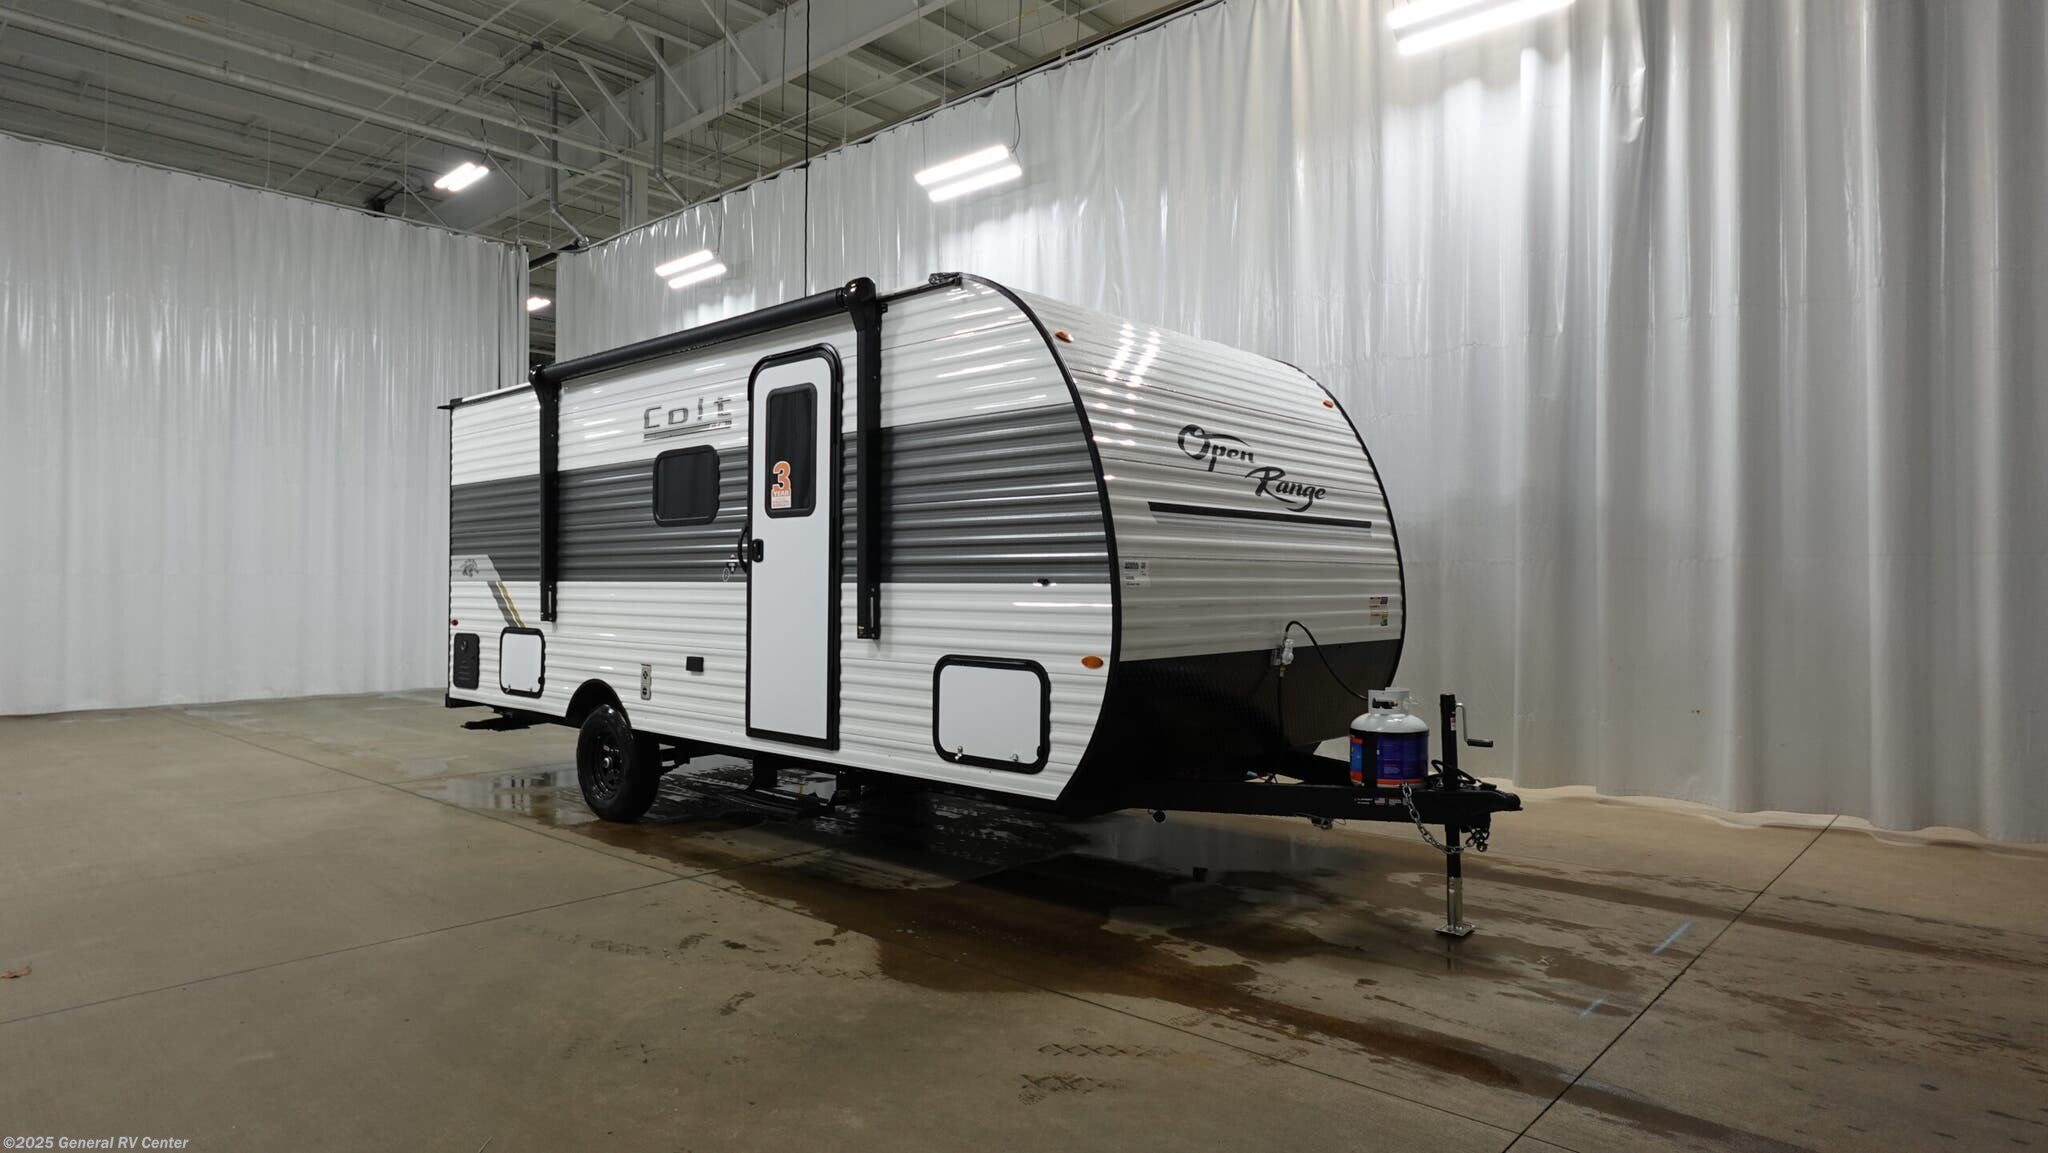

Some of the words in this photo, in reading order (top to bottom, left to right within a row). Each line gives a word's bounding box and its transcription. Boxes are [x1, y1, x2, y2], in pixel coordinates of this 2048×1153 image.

[1177, 424, 1254, 472] Open
[772, 460, 791, 490] 3
[1245, 466, 1327, 512] Range
